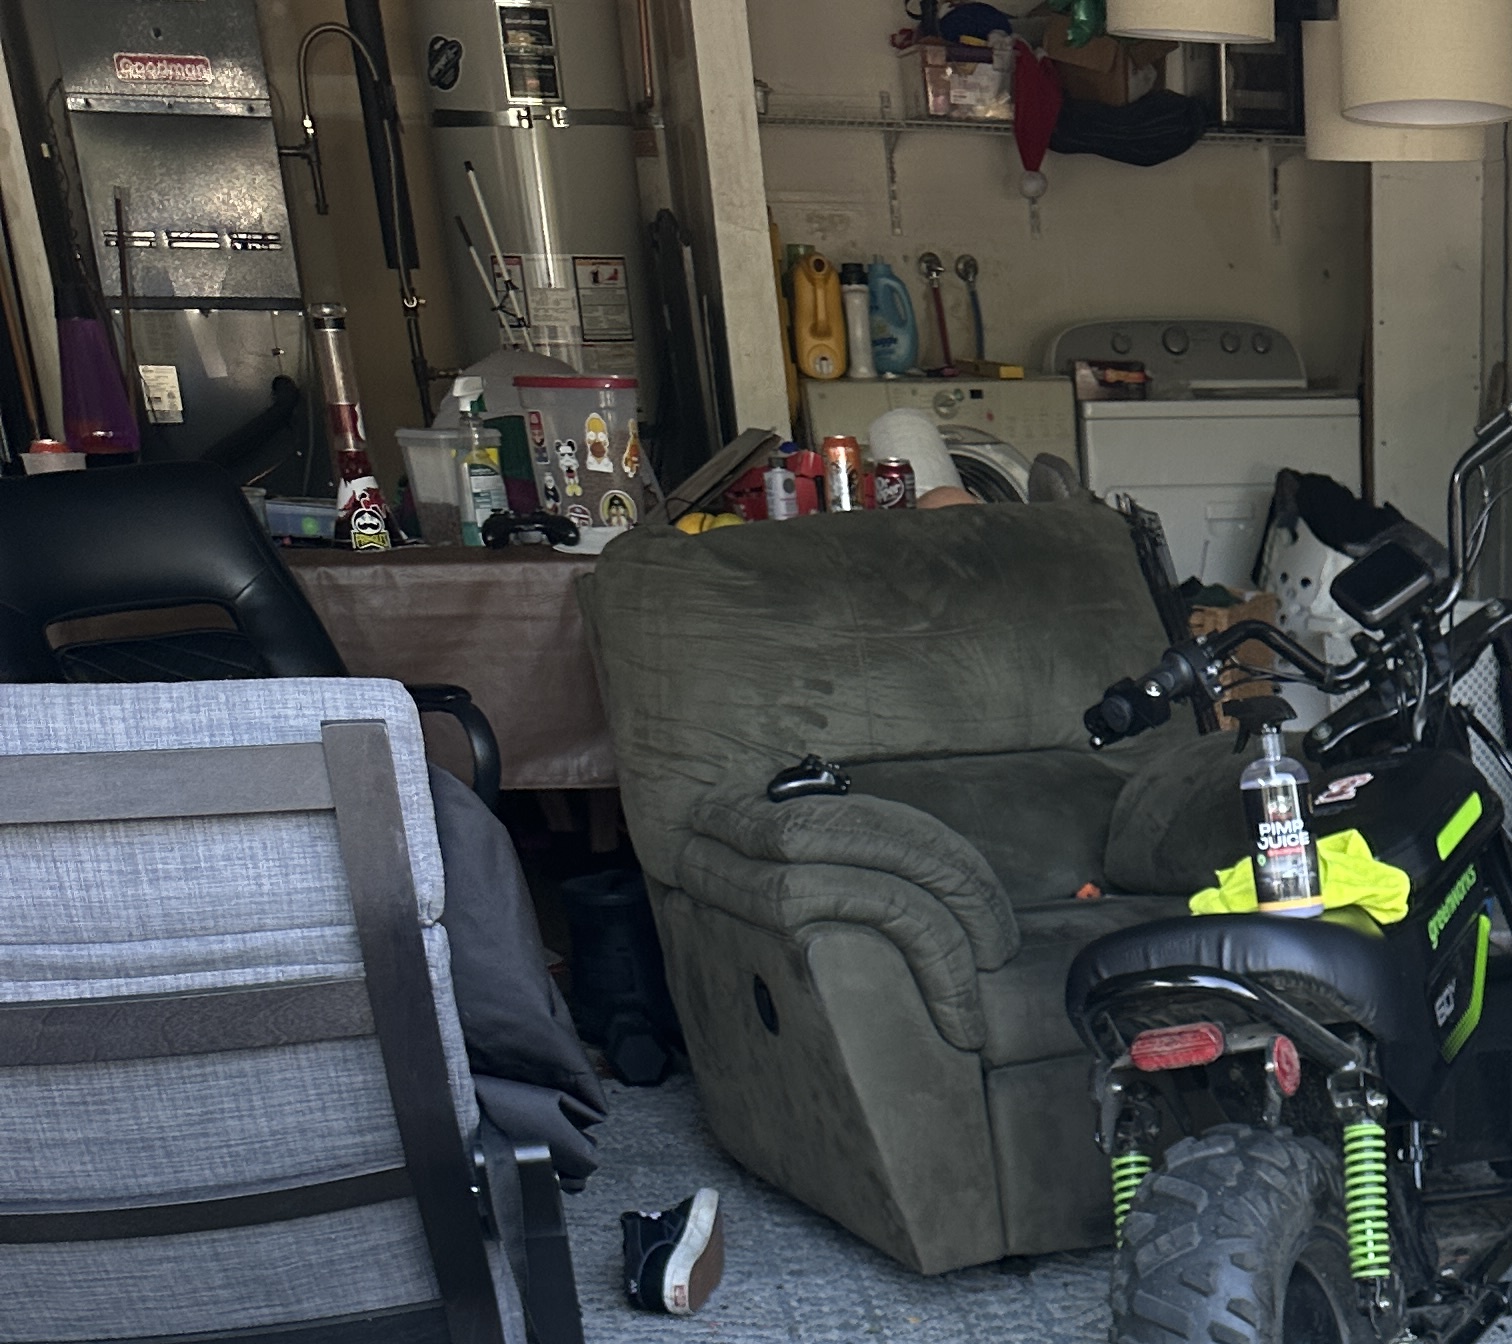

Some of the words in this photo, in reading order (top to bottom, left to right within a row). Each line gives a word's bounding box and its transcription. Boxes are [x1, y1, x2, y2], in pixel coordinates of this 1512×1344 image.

[119, 58, 208, 80] Goodman
[1258, 819, 1304, 836] PIMP
[1257, 831, 1310, 850] JUICE
